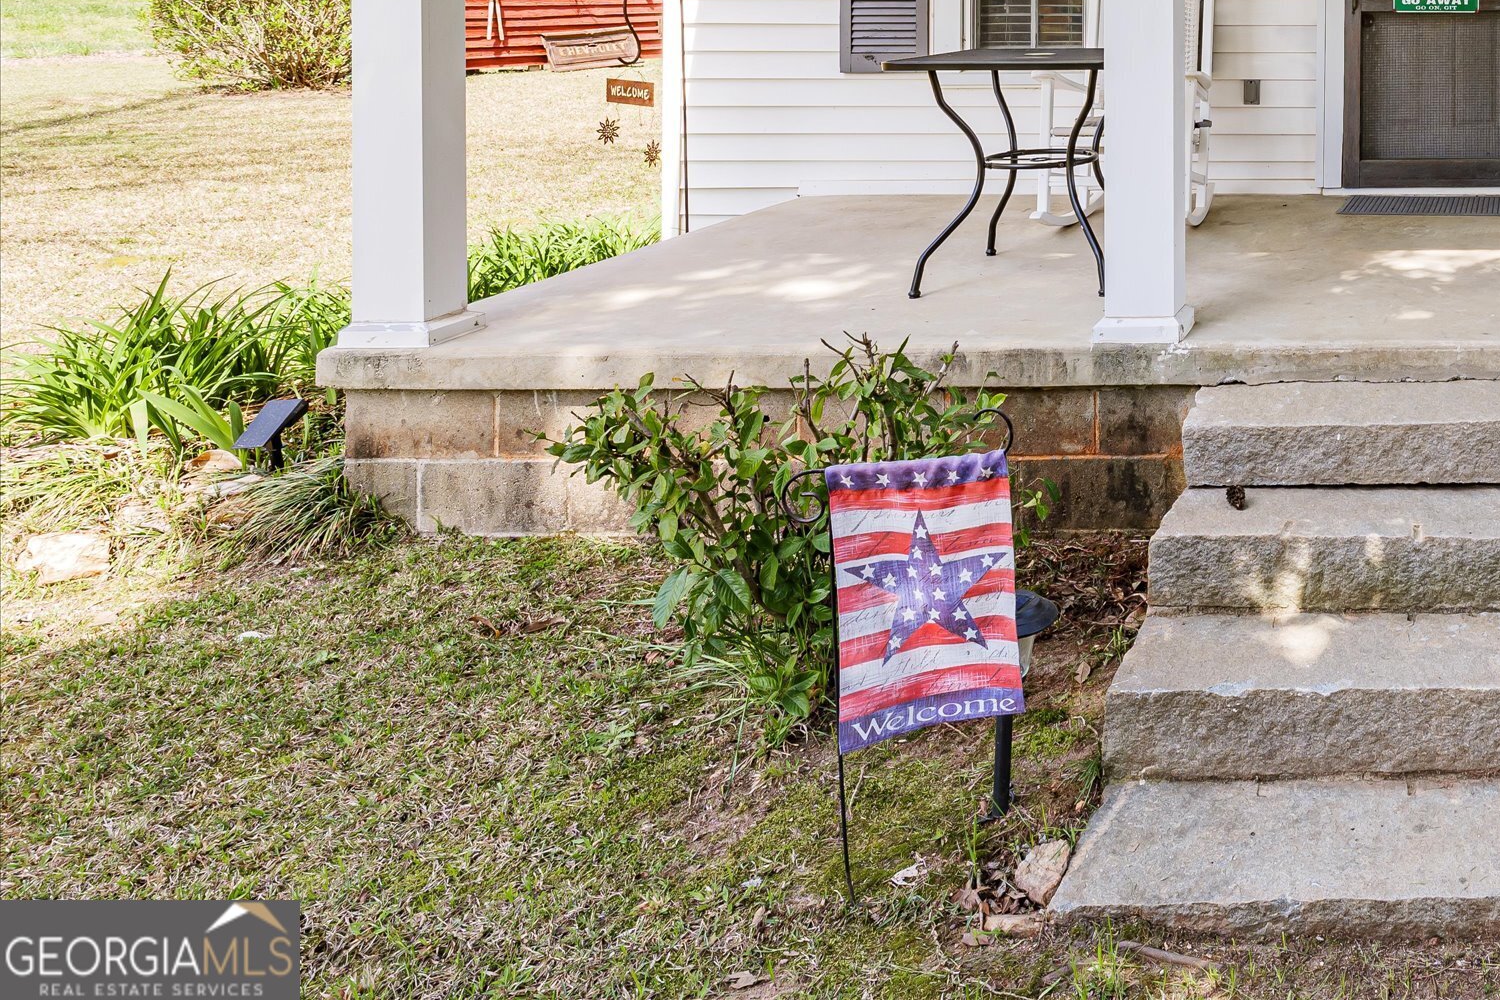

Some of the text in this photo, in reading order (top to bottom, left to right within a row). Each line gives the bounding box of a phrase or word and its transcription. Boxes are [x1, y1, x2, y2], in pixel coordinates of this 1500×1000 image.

[560, 42, 626, 56] CHEVROLET
[610, 85, 650, 101] WELCOME
[851, 698, 1017, 741] Welcome
